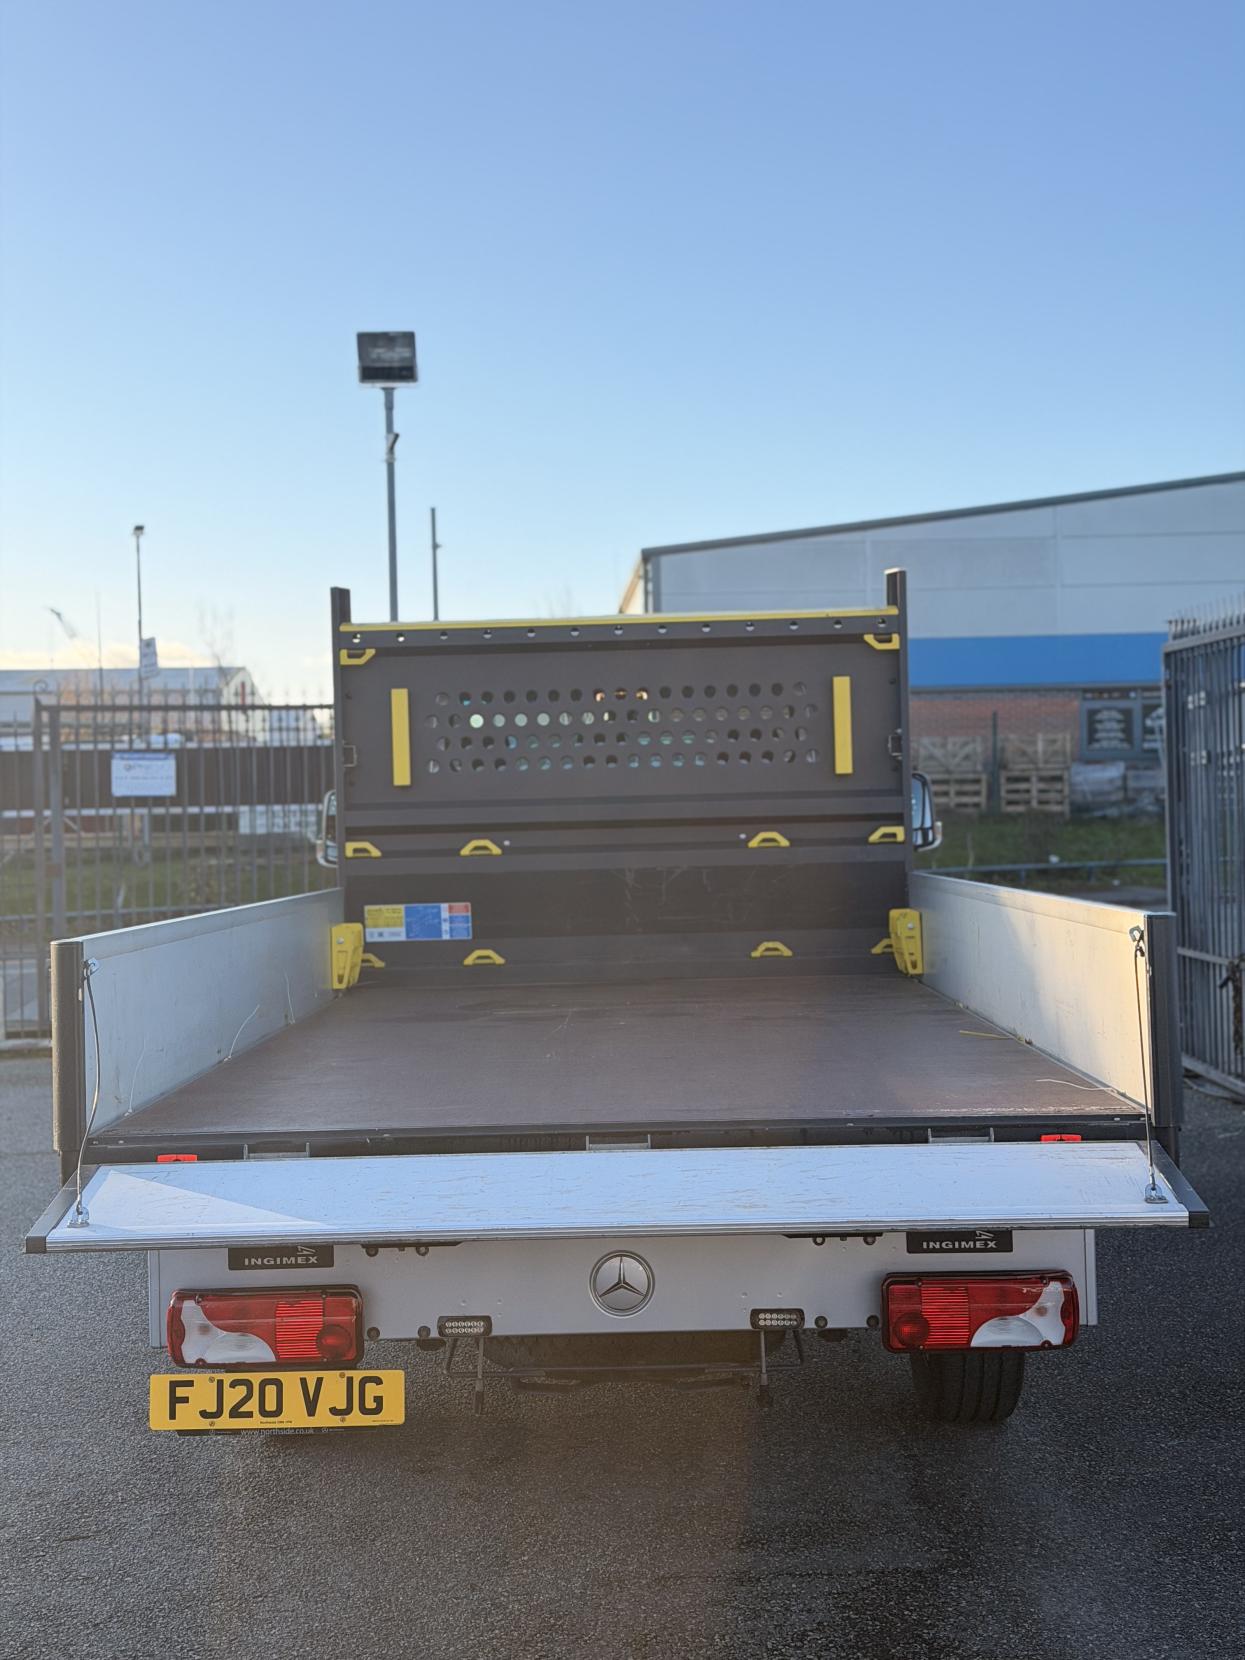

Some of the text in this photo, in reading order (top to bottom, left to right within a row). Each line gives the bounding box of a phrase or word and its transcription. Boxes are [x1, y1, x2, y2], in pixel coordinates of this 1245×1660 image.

[922, 1240, 998, 1249] INGIMEX
[244, 1256, 318, 1266] INGIMEX
[168, 1375, 384, 1421] FJ20 VJG
